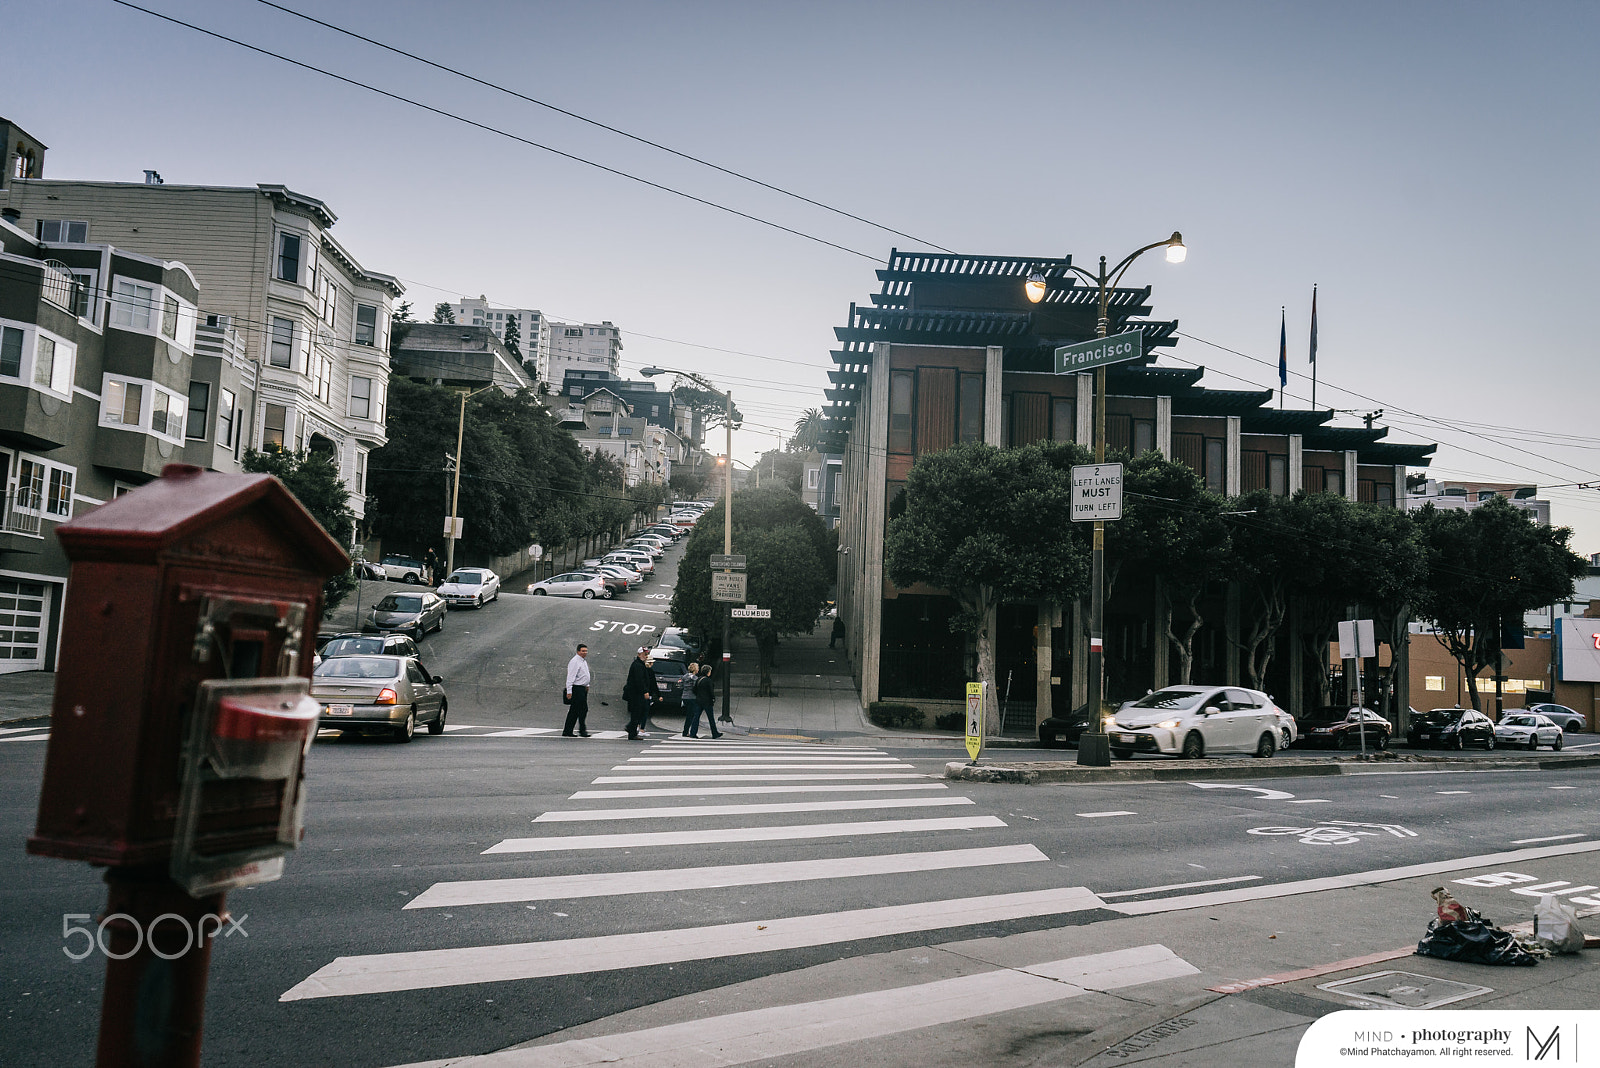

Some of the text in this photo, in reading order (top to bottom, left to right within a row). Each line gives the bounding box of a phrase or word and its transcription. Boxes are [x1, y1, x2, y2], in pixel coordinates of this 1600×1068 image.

[1063, 342, 1132, 367] Francisco
[1094, 467, 1100, 476] 2
[1074, 477, 1120, 487] LEFT LANES
[1082, 488, 1110, 498] MUST
[1075, 503, 1116, 512] TURN LEFT
[589, 620, 657, 635] STOP
